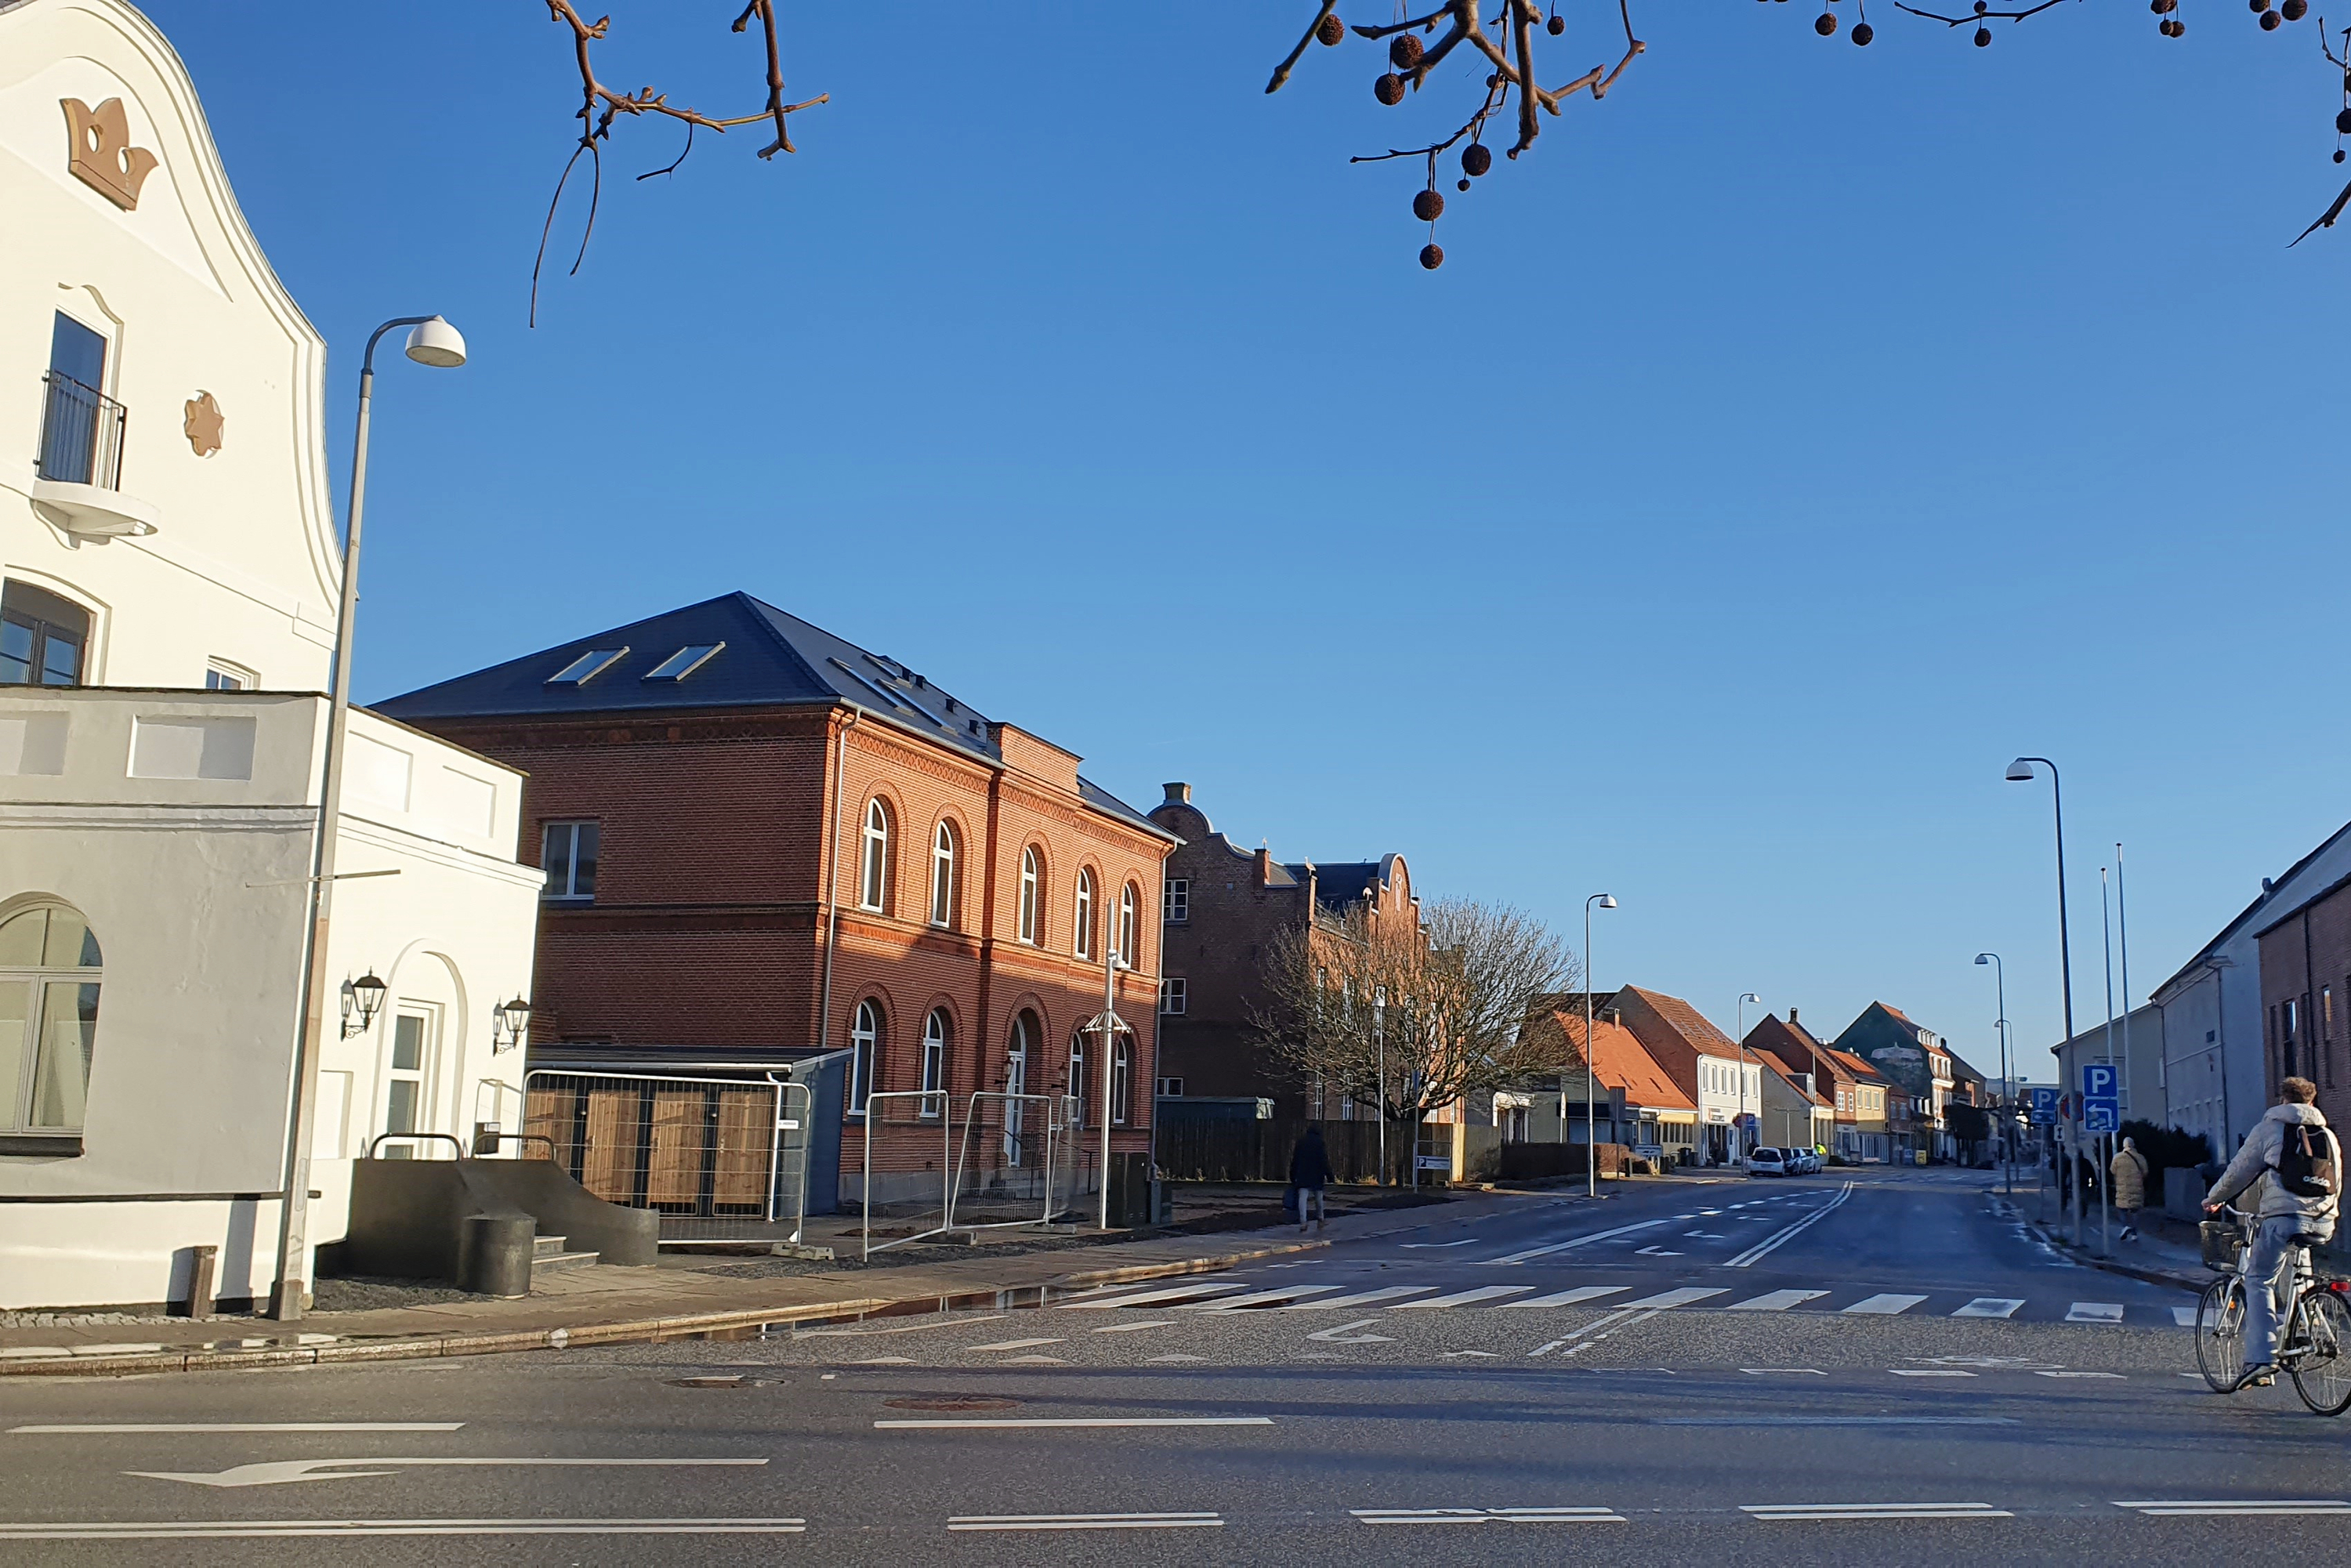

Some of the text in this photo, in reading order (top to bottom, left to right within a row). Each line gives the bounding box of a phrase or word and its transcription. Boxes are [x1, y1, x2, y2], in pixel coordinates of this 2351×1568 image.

[2092, 1069, 2110, 1093] P
[2038, 1091, 2052, 1108] P
[1418, 1157, 1425, 1167] P
